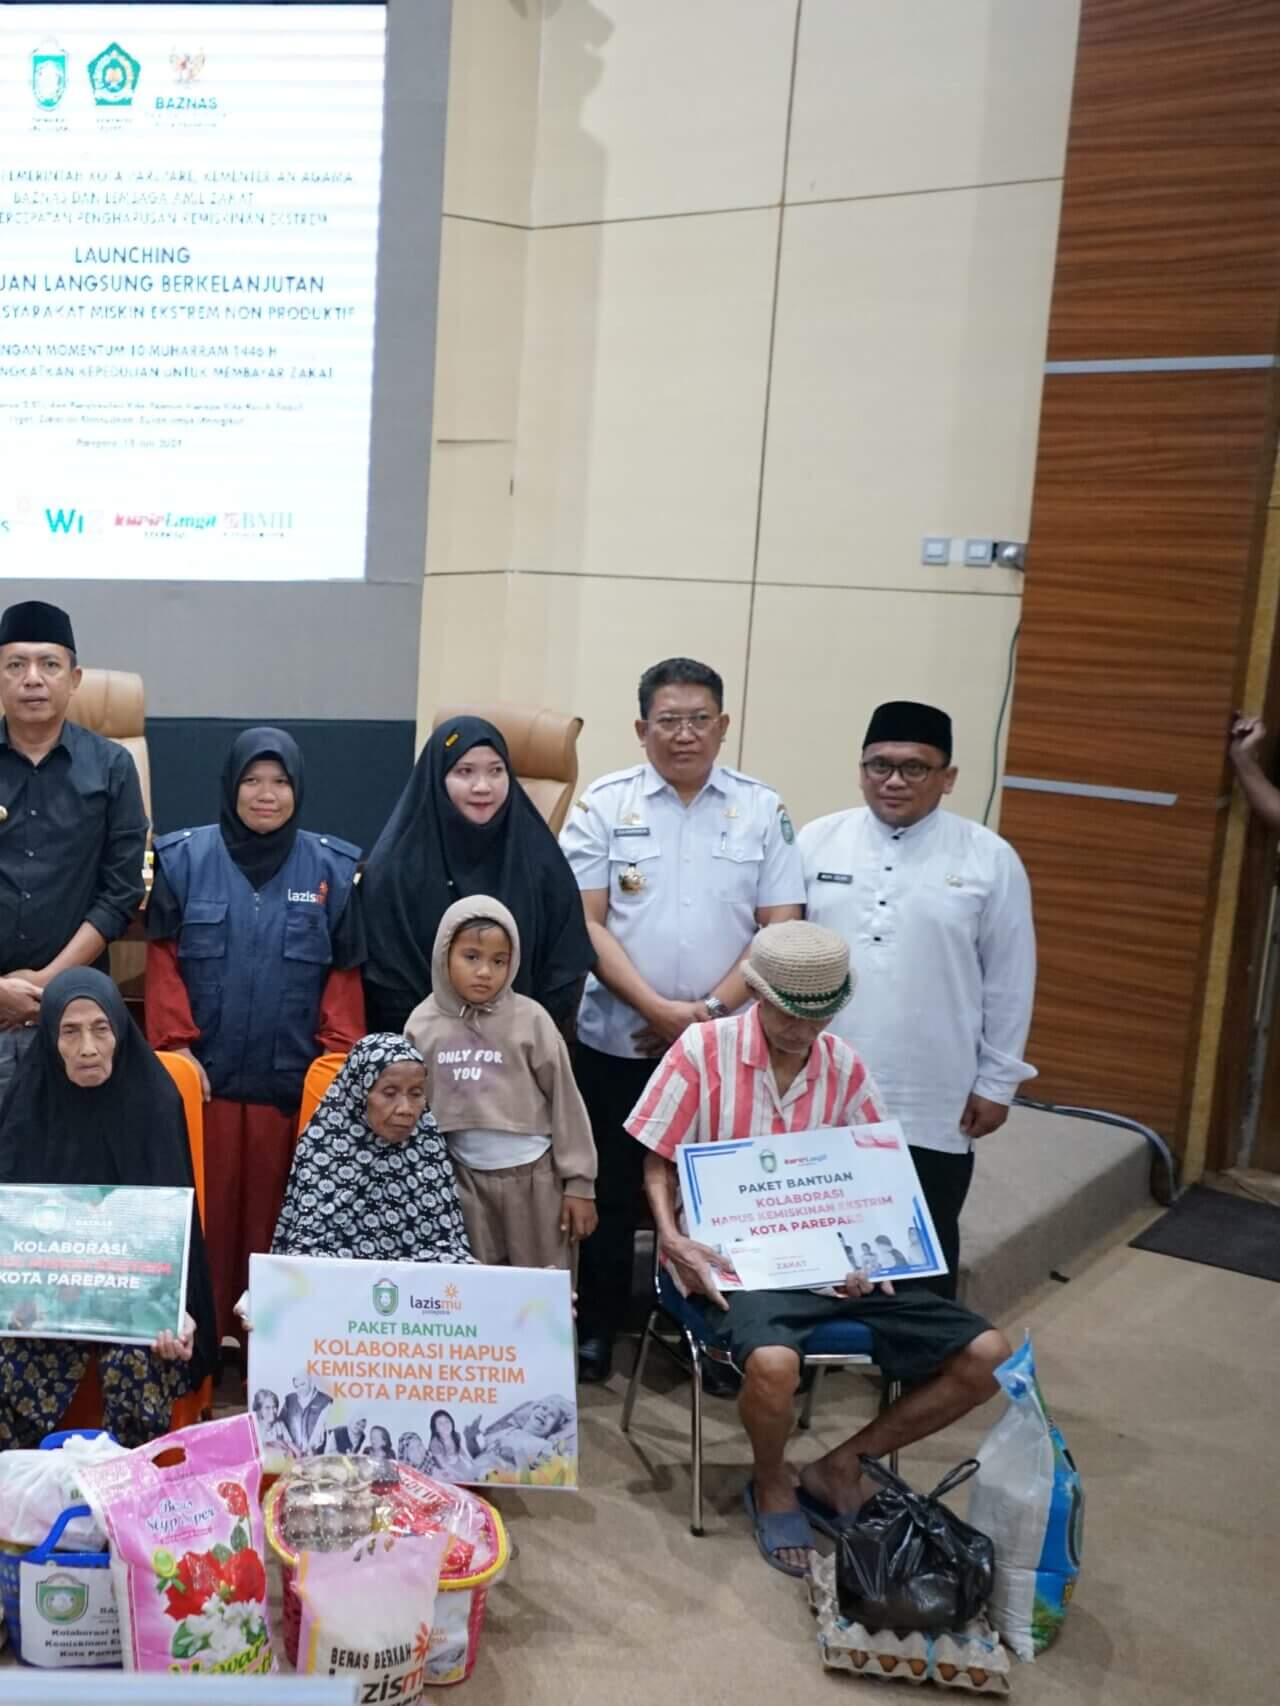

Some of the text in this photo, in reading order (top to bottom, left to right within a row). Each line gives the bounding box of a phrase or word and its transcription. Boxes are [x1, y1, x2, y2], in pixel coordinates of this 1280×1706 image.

[155, 97, 218, 110] BAZNAS
[1, 169, 83, 183] EMERINTAH
[204, 169, 296, 183] KEMENTERAN
[74, 246, 191, 264] LAUNCHING
[44, 273, 153, 292] LANGSUNG
[161, 274, 324, 293] BERKELANJUTAN
[90, 304, 145, 319] MISKIN
[151, 305, 219, 320] EKSTREM
[225, 305, 262, 320] NON
[269, 305, 355, 321] PRODUKTIF
[46, 344, 125, 357] MOMENTUM
[131, 345, 146, 357] 10
[149, 345, 229, 358] MUHARRAM
[233, 346, 265, 358] 1446
[79, 366, 159, 378] KEPEDULIAN
[164, 366, 208, 378] UNTUK
[213, 366, 285, 379] MEMBAYAR
[290, 367, 334, 379] ZAKAT
[437, 1048, 504, 1065] ONLY FOR
[452, 1066, 483, 1081] YOU
[738, 1171, 854, 1195] PAKET BANTUAN
[755, 1188, 845, 1209] KOLABORASI
[711, 1194, 895, 1227] HAPUS KEMISKINAN EKSTRIM
[749, 1221, 789, 1237] KOTA
[12, 1239, 128, 1256] KOLABORASI
[47, 1271, 141, 1289] PAREPARE
[409, 1294, 463, 1310] lazismu
[347, 1320, 478, 1339] PAKET BANTUAN
[313, 1338, 518, 1362] KOLABORASI HAPUS
[306, 1360, 526, 1385] KEMISKINAN EKSTRIM
[333, 1381, 498, 1405] KOTA PAREPARE
[51, 1629, 109, 1637] Kolaborasi
[45, 1639, 108, 1648] Kemiskinan
[330, 1643, 412, 1671] BERAS BERKAH
